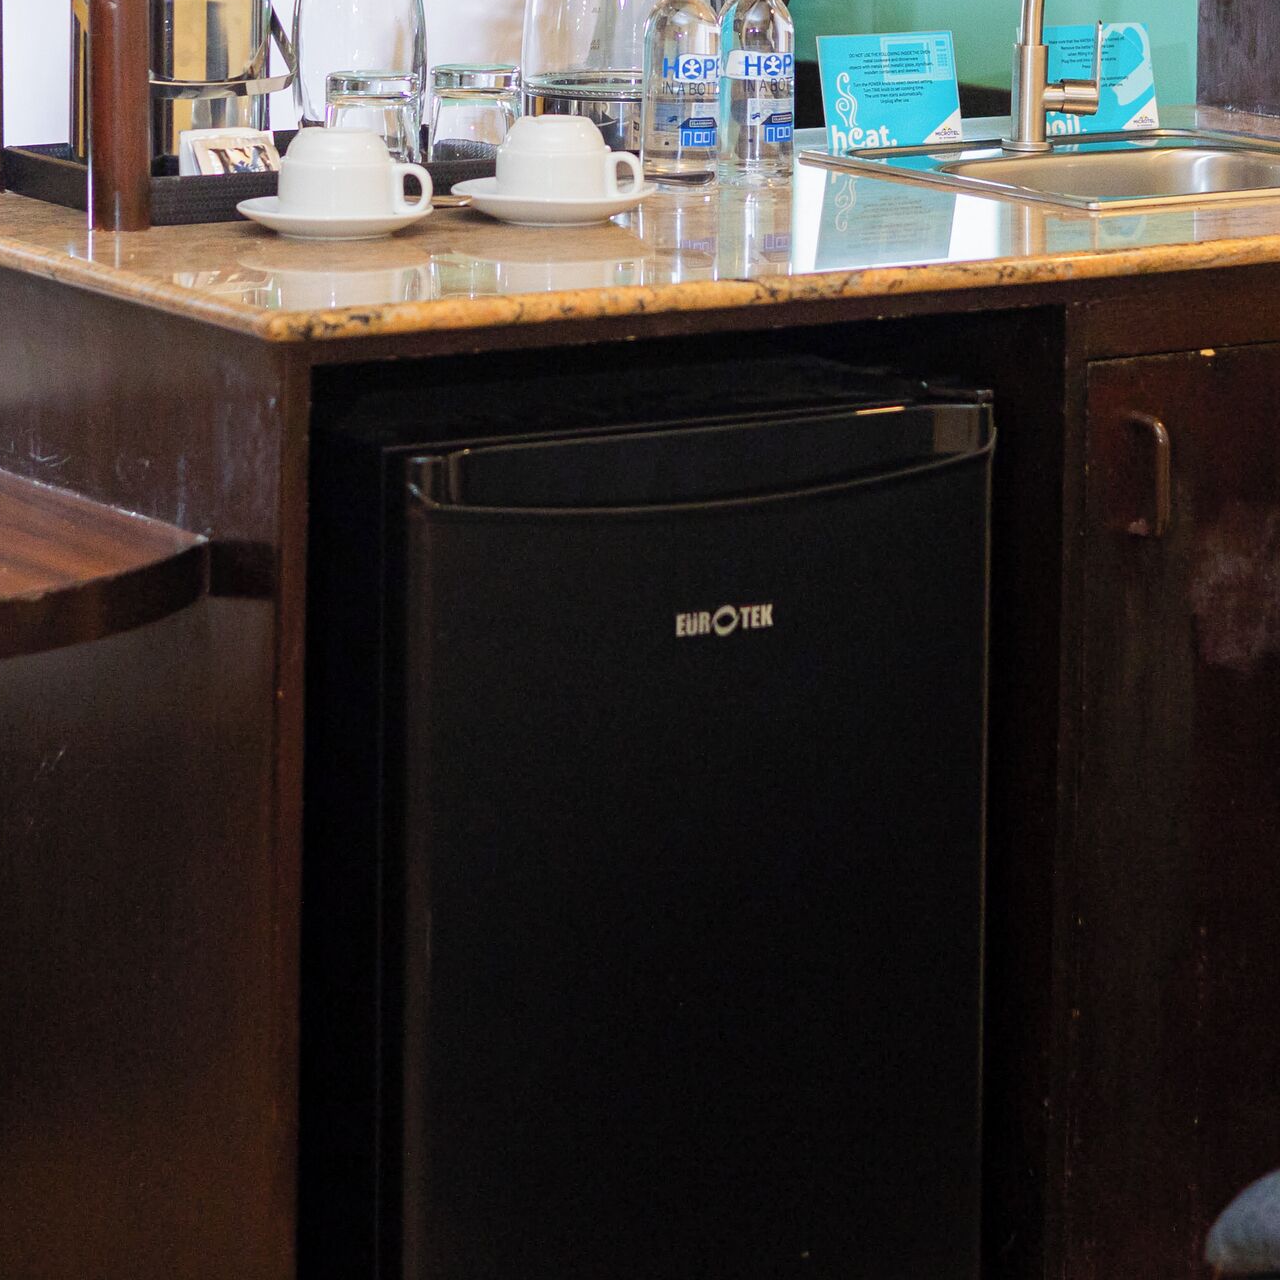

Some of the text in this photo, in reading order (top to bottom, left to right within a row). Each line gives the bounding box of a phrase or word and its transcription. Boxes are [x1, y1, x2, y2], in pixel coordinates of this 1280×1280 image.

[663, 81, 673, 94] IN
[677, 81, 685, 95] A
[744, 79, 755, 92] IN
[759, 79, 768, 91] A
[1046, 111, 1088, 136] oil.
[676, 604, 774, 637] EUROTEK
